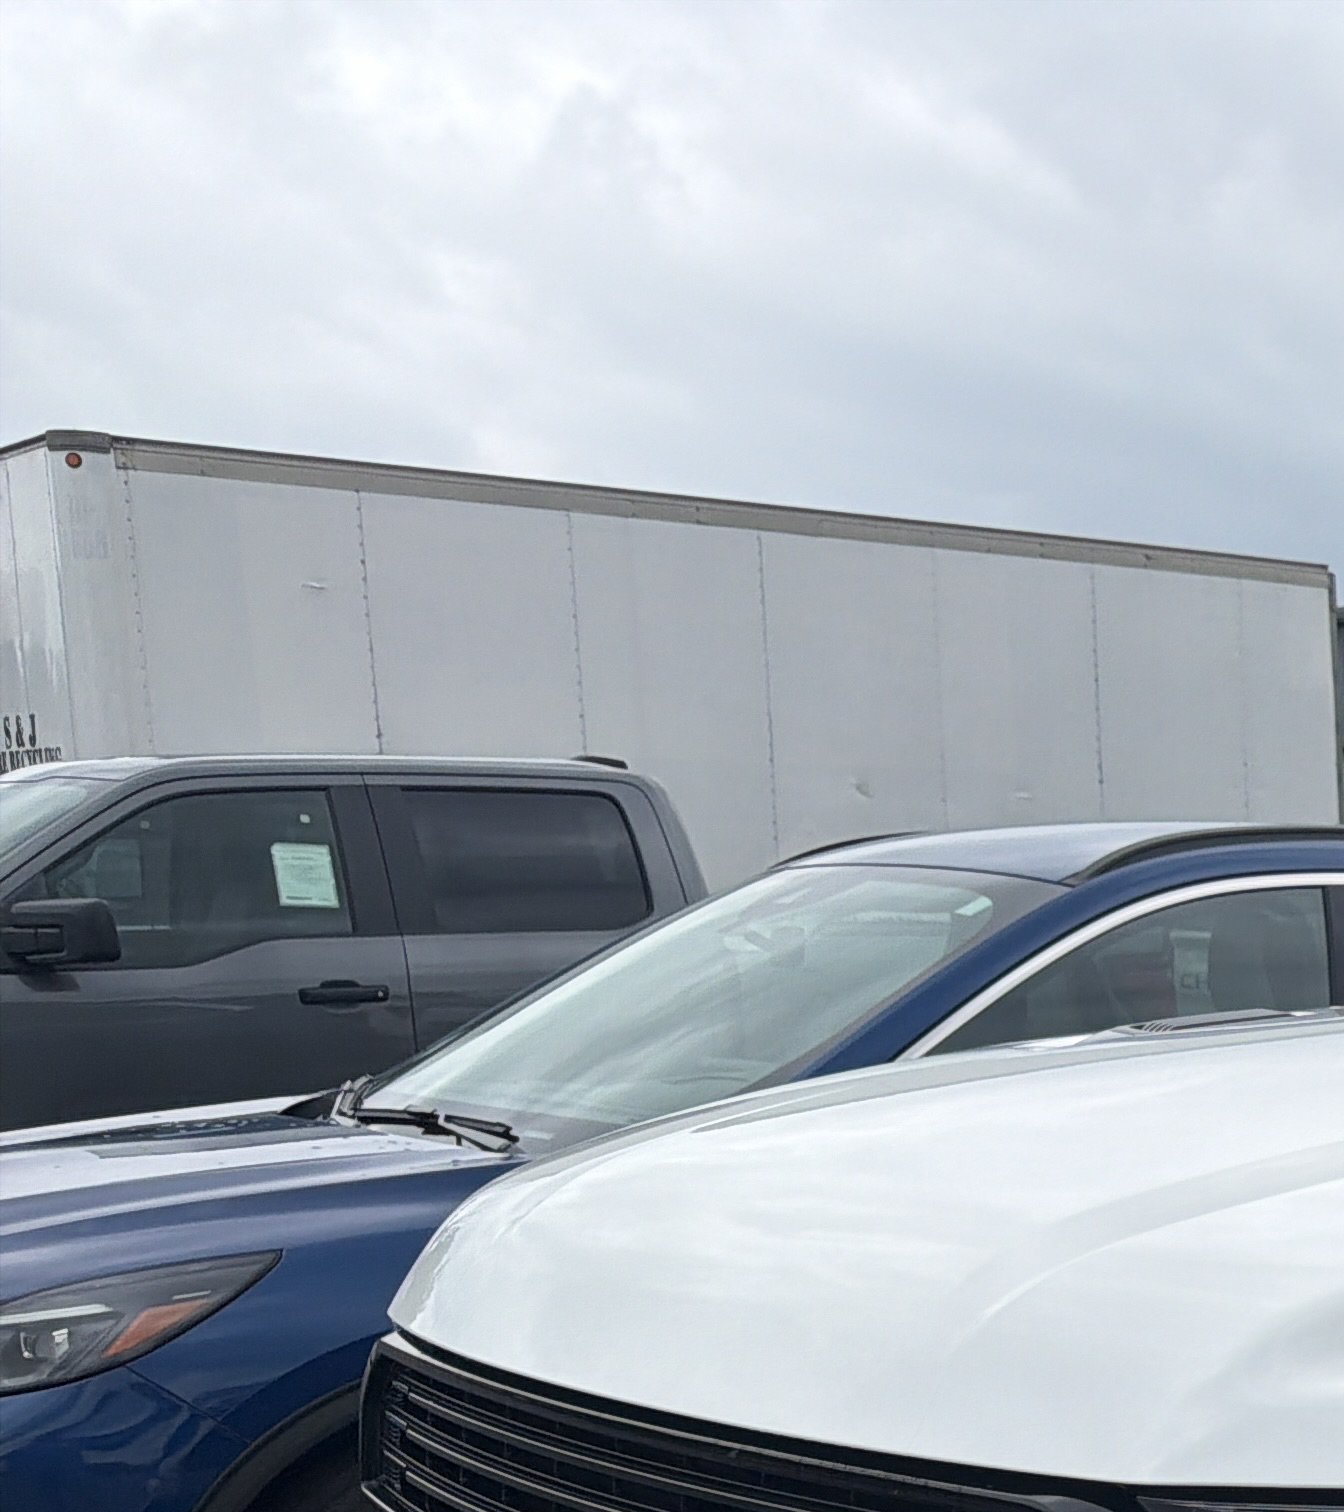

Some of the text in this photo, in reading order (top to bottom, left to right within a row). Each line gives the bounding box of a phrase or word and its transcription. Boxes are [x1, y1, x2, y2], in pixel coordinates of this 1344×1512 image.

[3, 713, 37, 750] S & J
